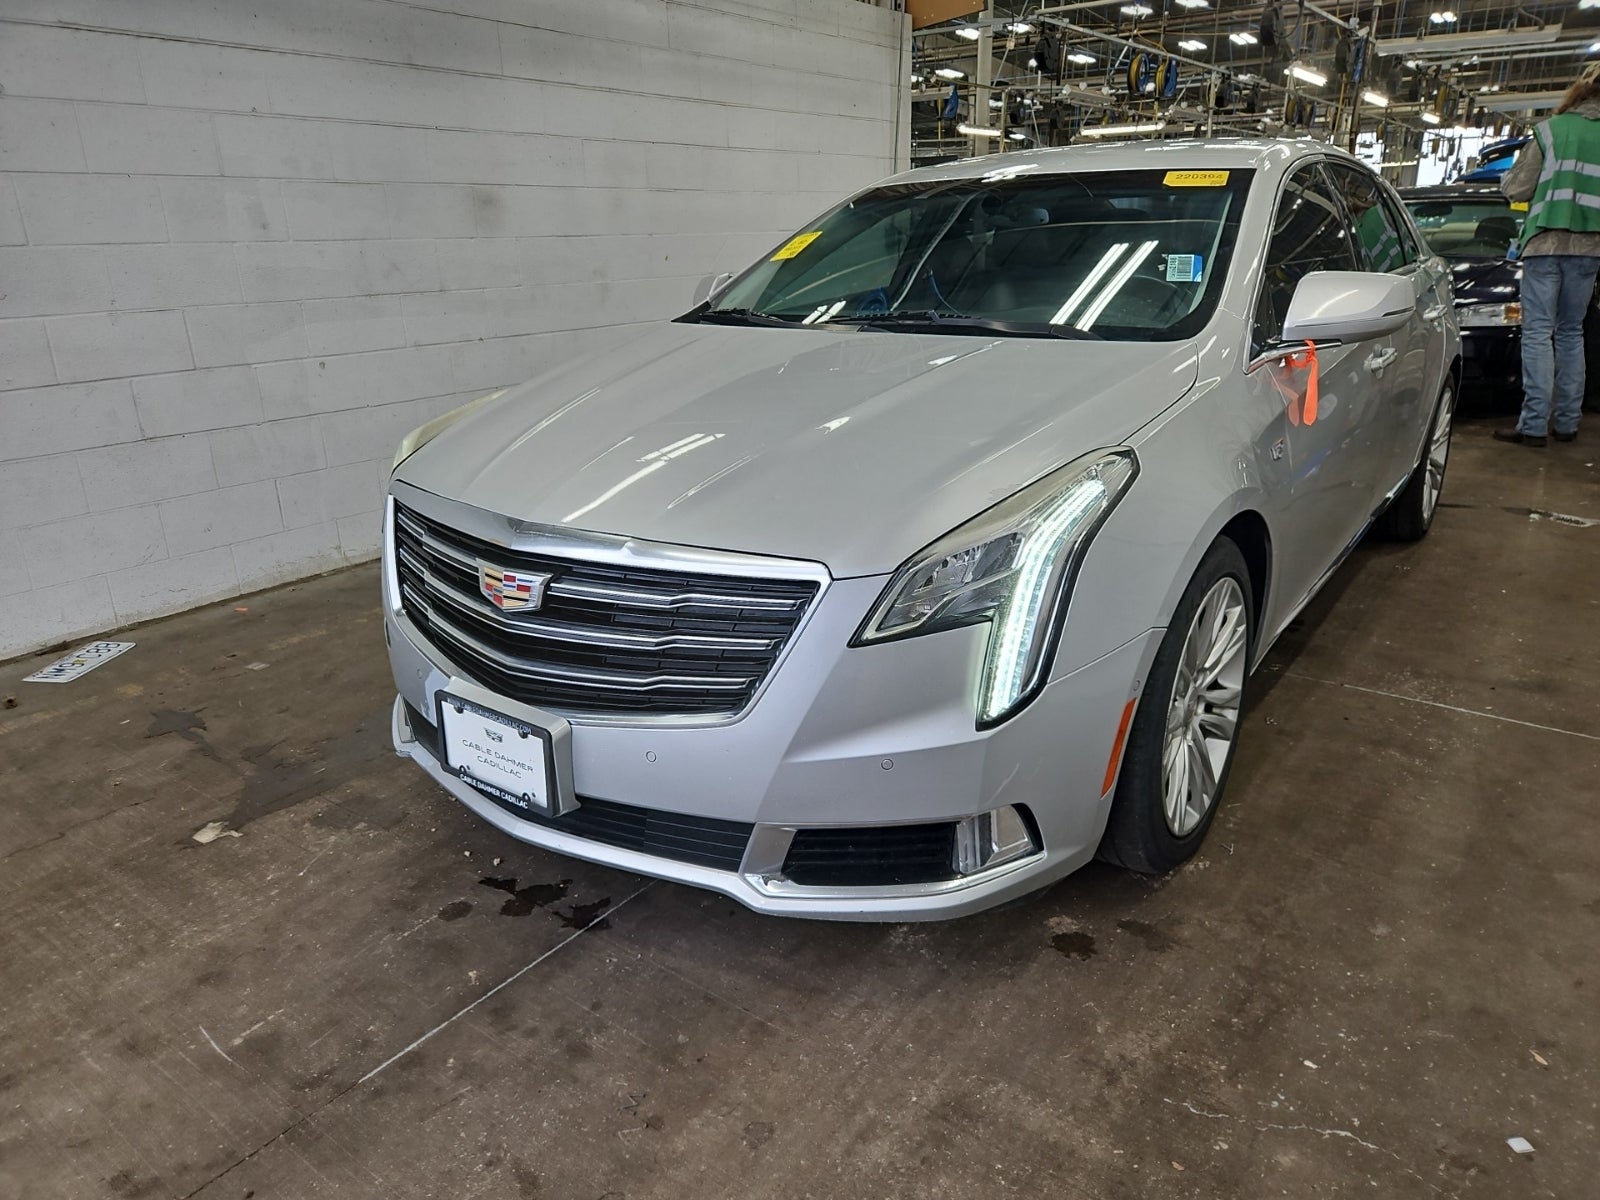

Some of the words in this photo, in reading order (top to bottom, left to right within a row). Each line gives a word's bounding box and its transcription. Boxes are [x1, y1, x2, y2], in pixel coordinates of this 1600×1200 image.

[462, 739, 492, 756] CABLE
[494, 751, 534, 772] DAHMER
[477, 755, 522, 779] CADILLAC
[460, 773, 477, 787] CABLE
[477, 781, 501, 797] DAHMER
[500, 791, 529, 809] CADILLAC
